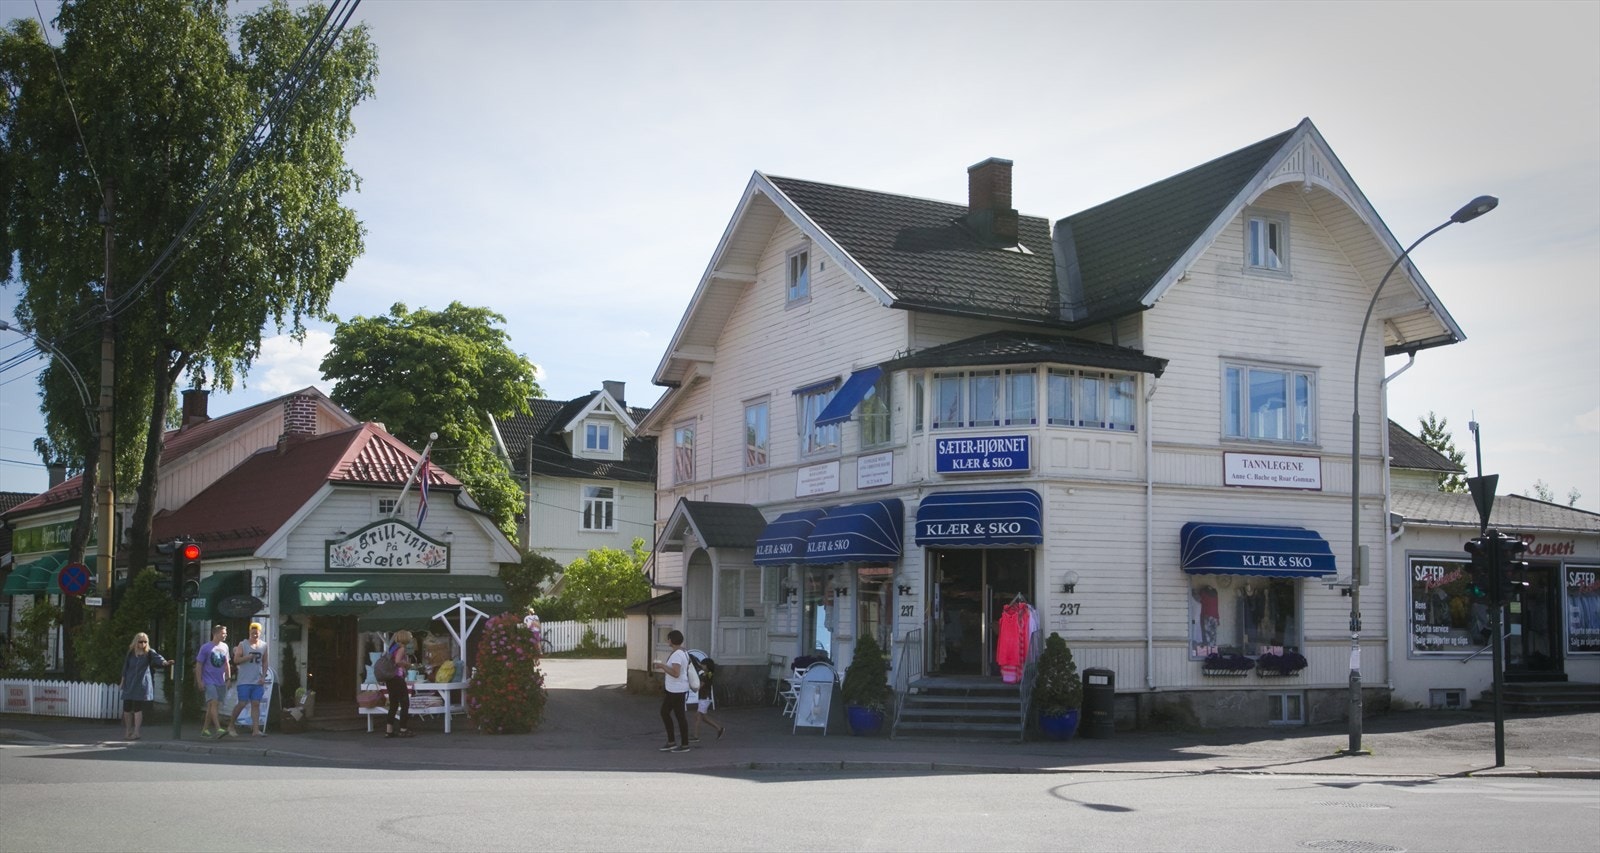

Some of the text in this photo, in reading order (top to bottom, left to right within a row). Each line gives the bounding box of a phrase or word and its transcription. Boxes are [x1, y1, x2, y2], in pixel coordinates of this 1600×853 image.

[938, 438, 1026, 457] SÆTER-HJØRNET
[952, 457, 1012, 470] KLÆR & SKO
[1242, 459, 1304, 471] TANNLEGENE
[926, 522, 1021, 536] KLÆR & SKO
[756, 543, 794, 555] KLÆR & SKO
[807, 538, 851, 553] KLÆR & SKO
[363, 550, 411, 567] Sæter
[1242, 555, 1312, 568] KLÆR & SKO
[1414, 565, 1444, 581] SÆTER
[1569, 571, 1596, 587] SÆTER
[191, 597, 207, 608] GAVER
[901, 605, 914, 617] 237
[1059, 603, 1080, 616] 237
